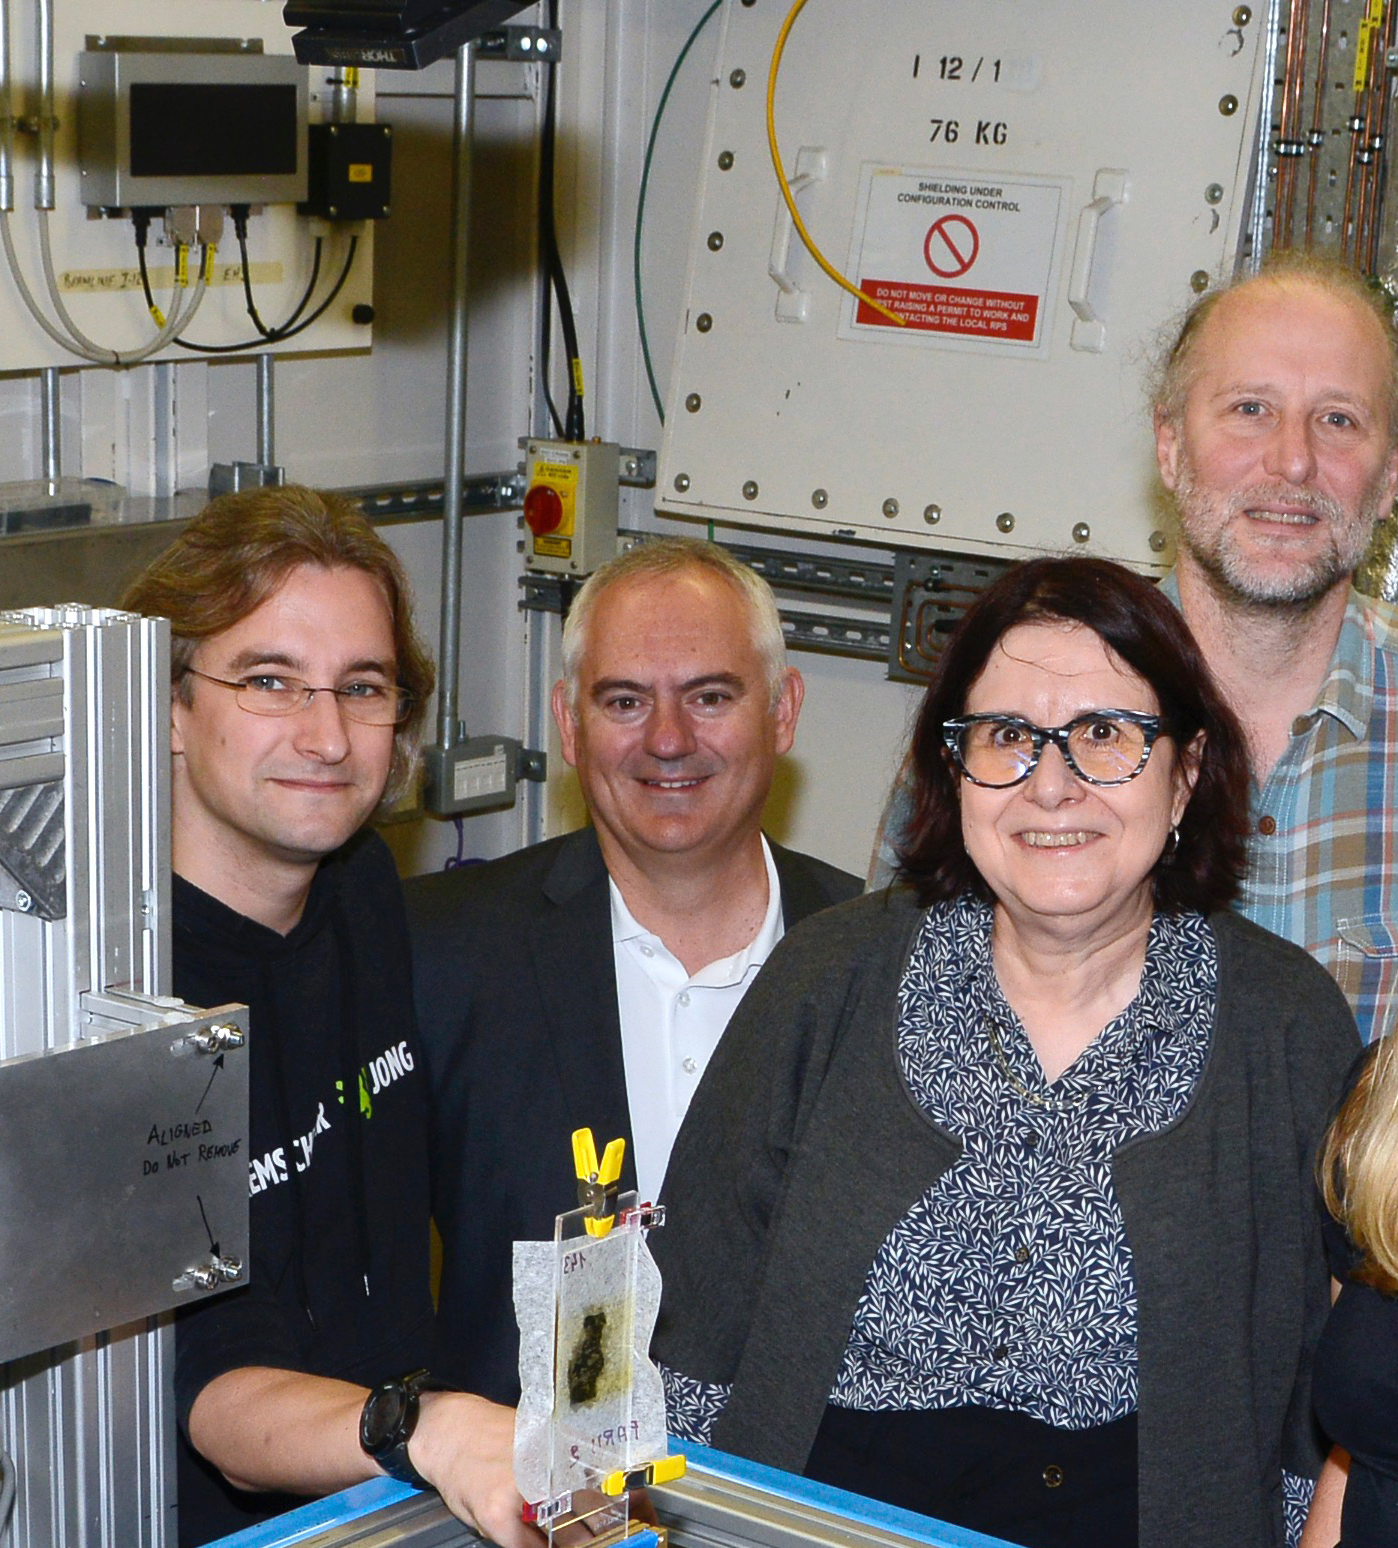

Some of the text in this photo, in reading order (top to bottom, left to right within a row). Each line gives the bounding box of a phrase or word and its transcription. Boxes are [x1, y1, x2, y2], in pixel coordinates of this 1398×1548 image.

[939, 56, 963, 80] 12
[930, 119, 1008, 145] 76 KG
[918, 182, 1003, 197] SHIELDING UNDER
[897, 193, 1021, 212] CONFIGURATION CONTROL
[876, 288, 1025, 310] DO NOT MOVE OR CHANGE WITHOUT
[894, 301, 927, 312] RAISING
[936, 306, 967, 316] PERMIT
[970, 308, 981, 317] TO
[982, 310, 1009, 320] WORK
[1011, 312, 1029, 322] AND
[942, 316, 958, 326] THE
[959, 319, 987, 330] LOCAL
[989, 321, 1007, 331] RPS
[369, 1041, 414, 1094] JONG
[147, 1120, 213, 1146] ALIGNED
